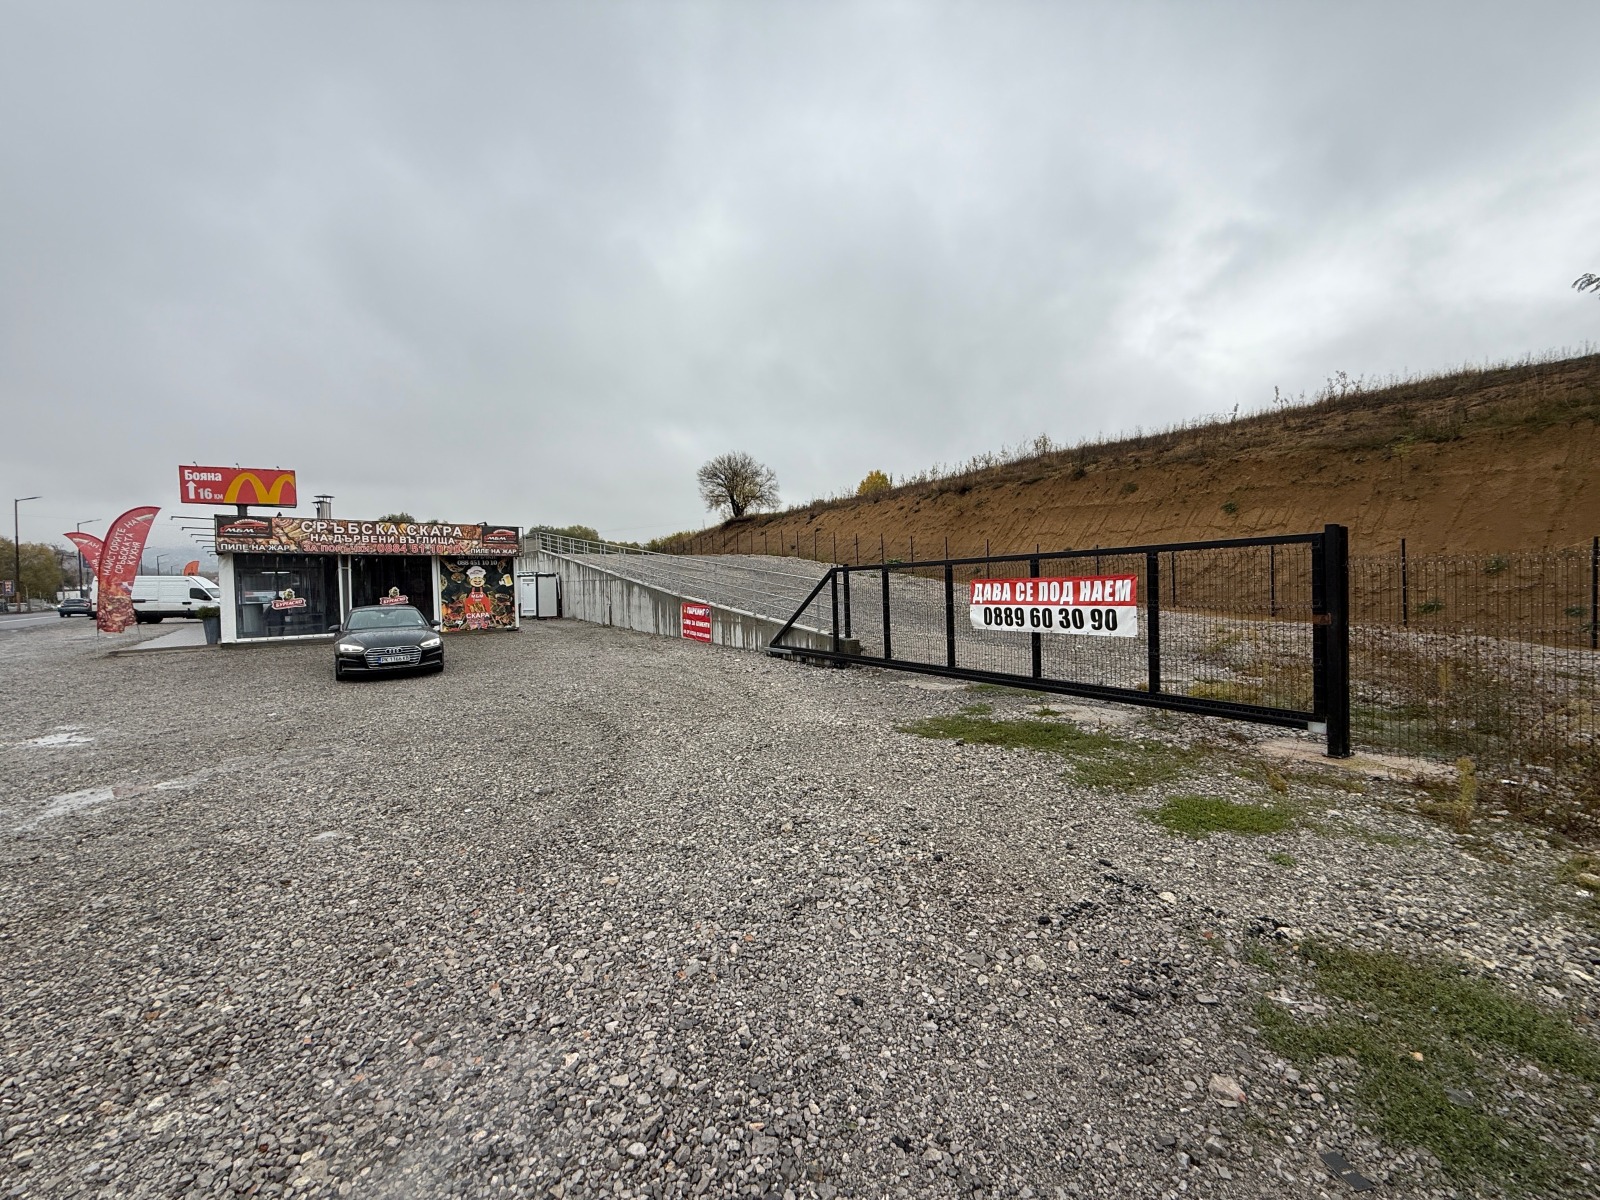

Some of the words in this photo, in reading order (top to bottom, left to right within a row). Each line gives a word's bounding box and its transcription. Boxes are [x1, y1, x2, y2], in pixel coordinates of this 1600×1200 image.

[184, 469, 222, 481] Бояна
[198, 488, 213, 499] 16
[124, 517, 139, 528] НА
[301, 521, 400, 535] СРЪБСКА
[407, 525, 463, 537] СКАРА
[310, 533, 329, 542] НА
[333, 534, 395, 544] ДЪРВЕНИ
[400, 536, 455, 545] ВЪГЛИЩА
[127, 541, 141, 565] КУХНЯ
[220, 543, 249, 551] ПИЛЕ
[303, 544, 319, 552] ЗА
[377, 544, 407, 553] 0884
[411, 544, 425, 553] 51
[115, 533, 134, 574] СРЪБСКАТА
[973, 582, 1011, 604] ДАВА
[1015, 582, 1034, 602] СЕ
[1038, 581, 1074, 605] ПОД
[1080, 580, 1132, 602] НАЕМ
[983, 606, 1024, 626] 0889
[1030, 607, 1053, 629] 60
[1058, 608, 1085, 630] 30
[1090, 608, 1118, 631] 90
